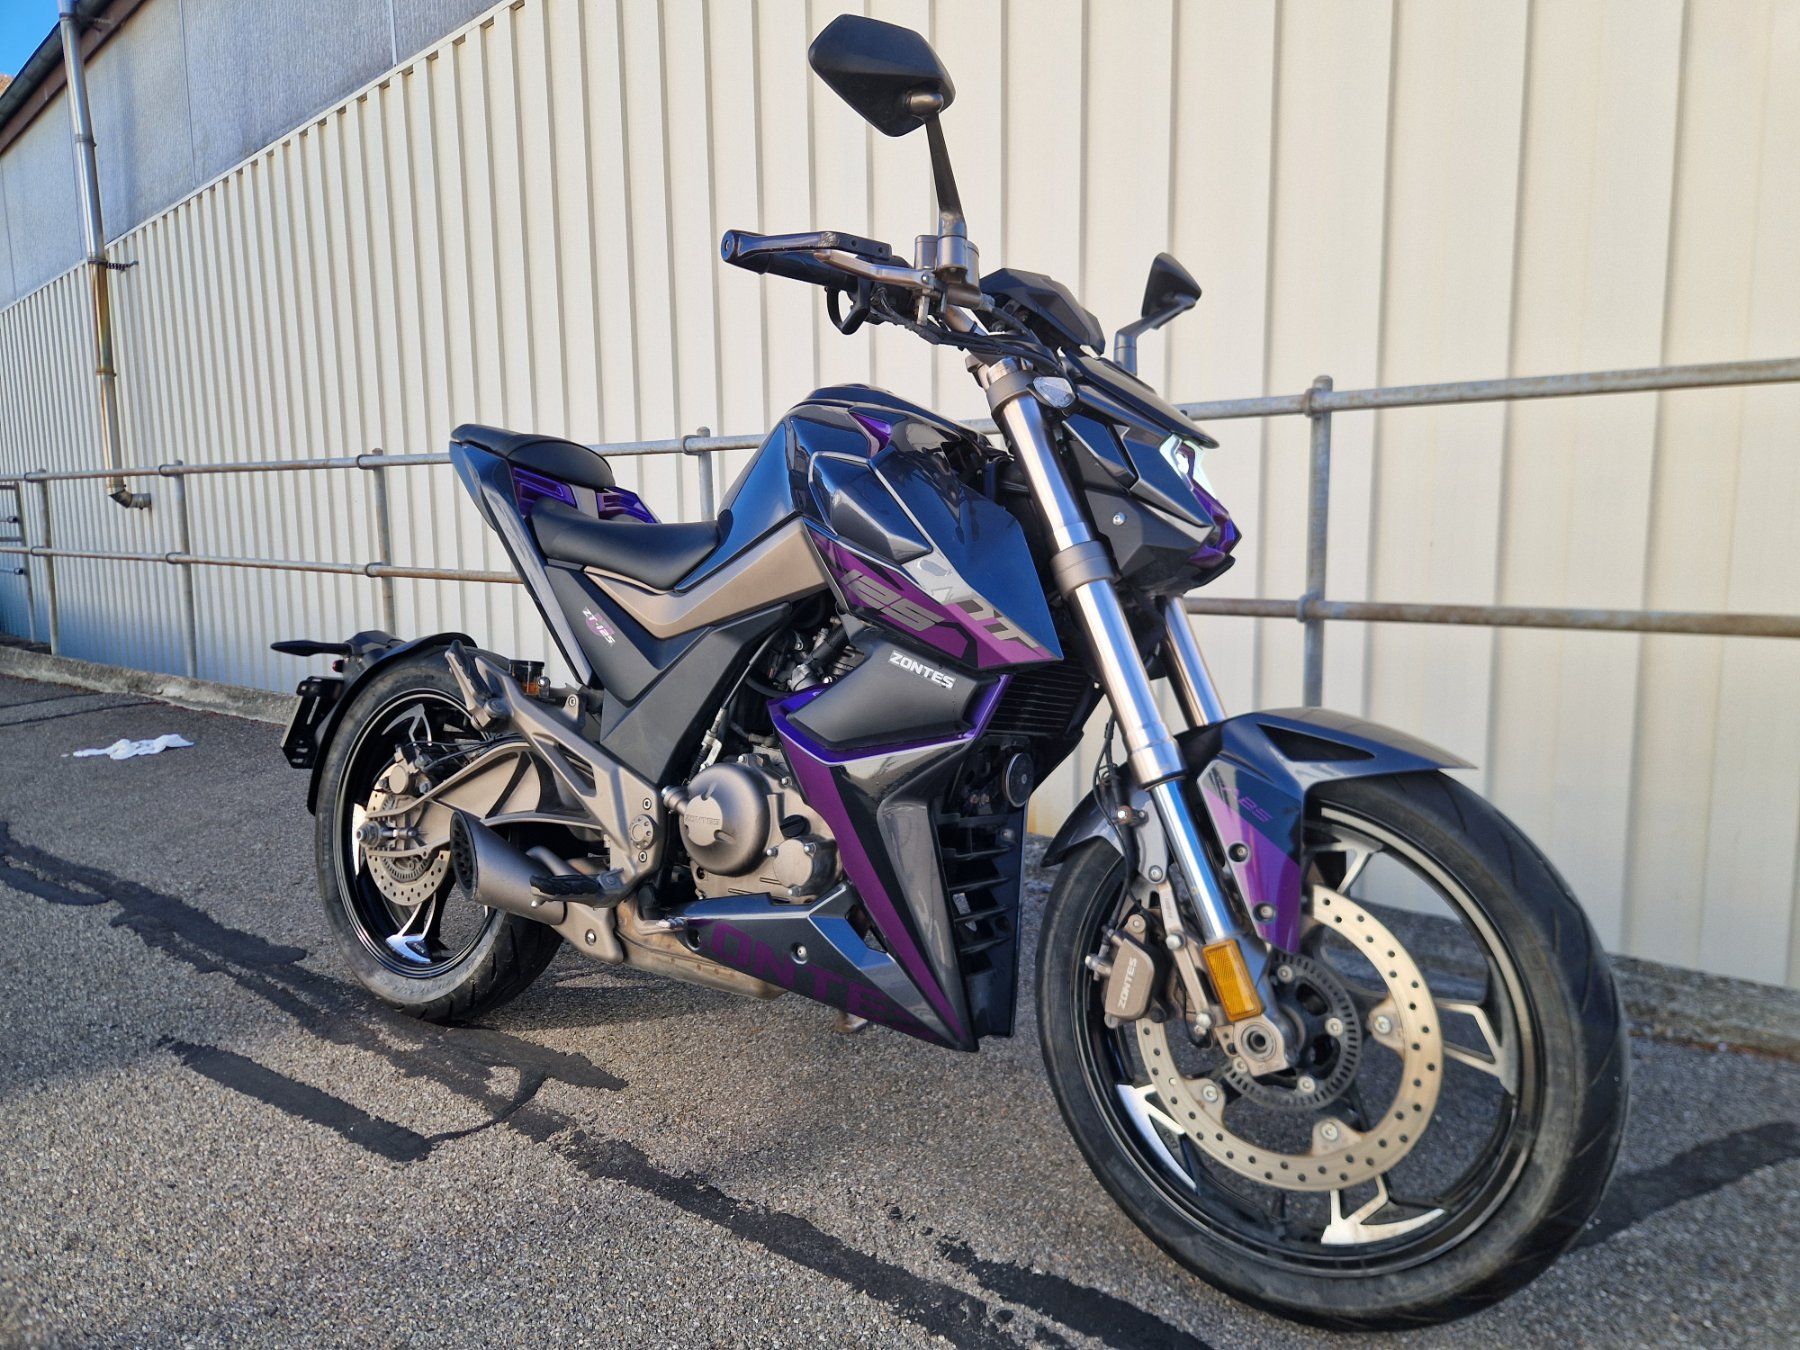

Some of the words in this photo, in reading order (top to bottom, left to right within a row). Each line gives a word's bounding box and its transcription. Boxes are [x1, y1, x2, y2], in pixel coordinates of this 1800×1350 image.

[840, 568, 945, 632] 125
[888, 651, 956, 690] ZONTES
[1118, 957, 1138, 1010] ZONTES
